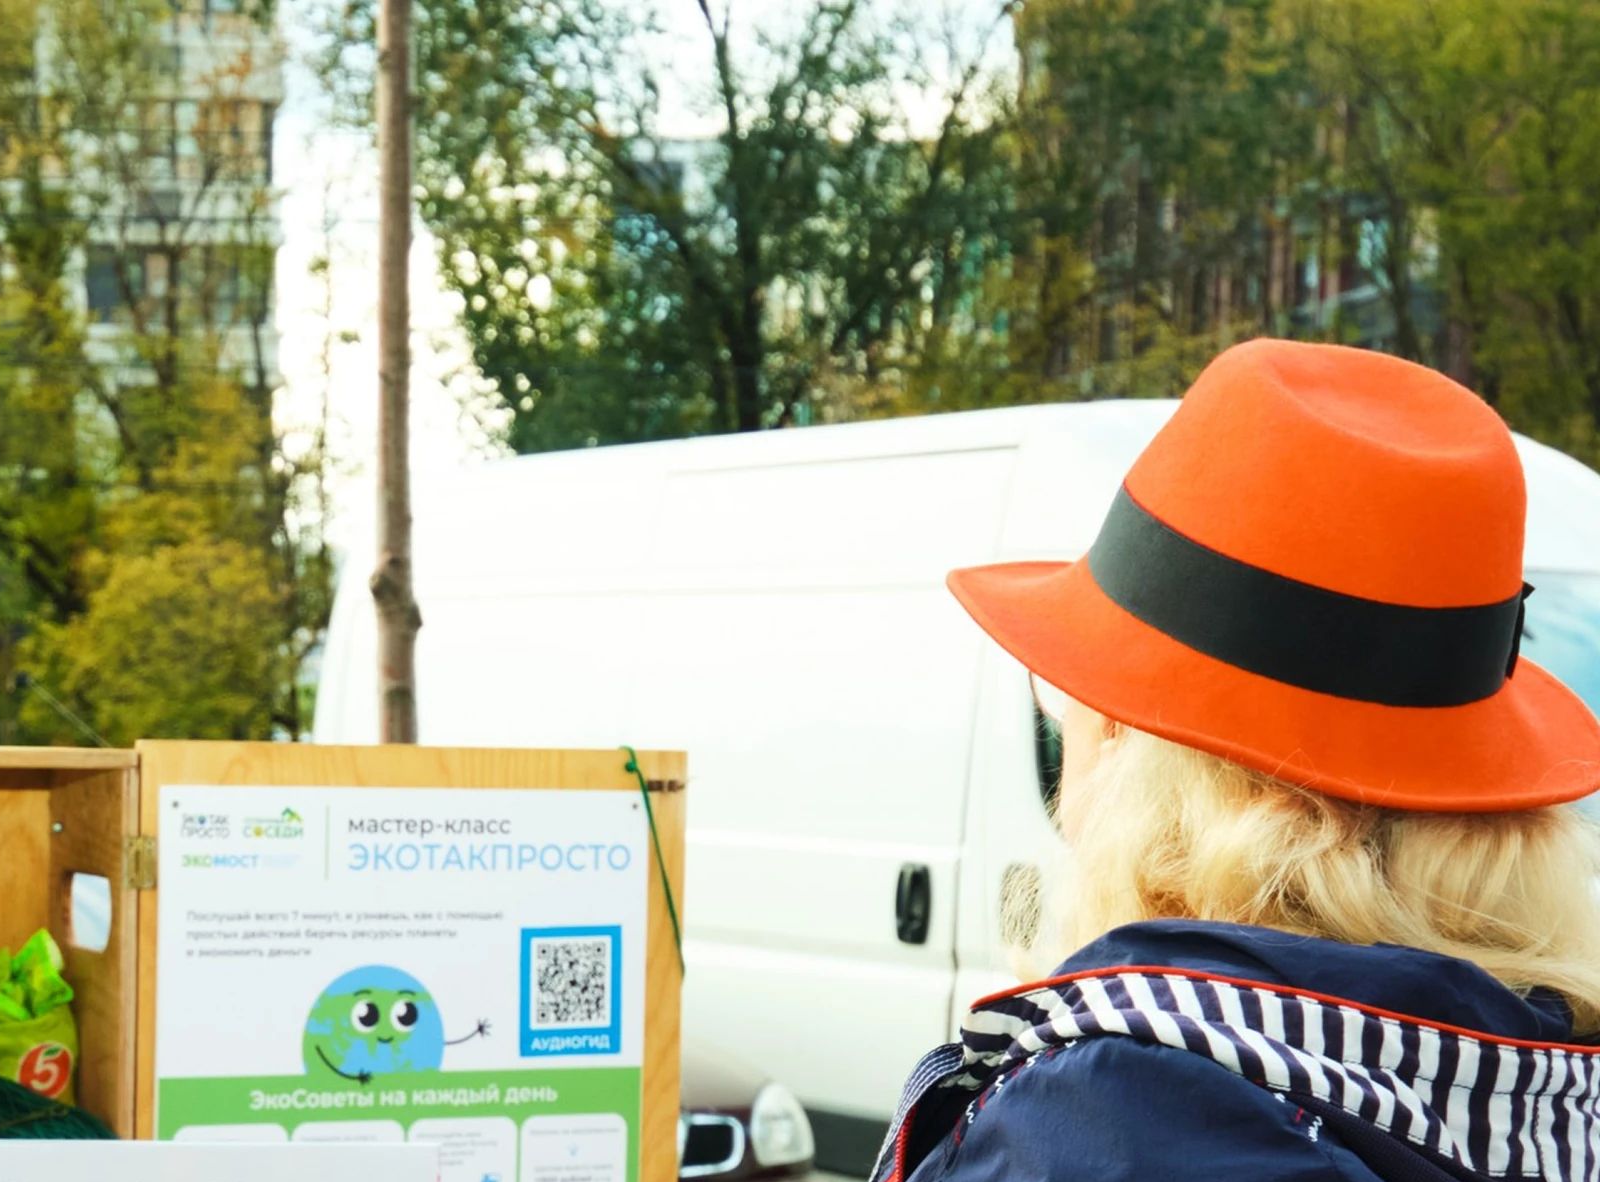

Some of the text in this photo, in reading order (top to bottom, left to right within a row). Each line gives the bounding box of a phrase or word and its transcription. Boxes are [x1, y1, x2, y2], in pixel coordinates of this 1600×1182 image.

[348, 818, 511, 838] мастер-класс
[182, 854, 259, 868] ЭКОМОСТ
[348, 843, 632, 871] ЭКОТАКПРОСТО
[531, 1034, 610, 1052] АУДИОГИД
[249, 1084, 558, 1110] ЭкоСоветы на каждый день
